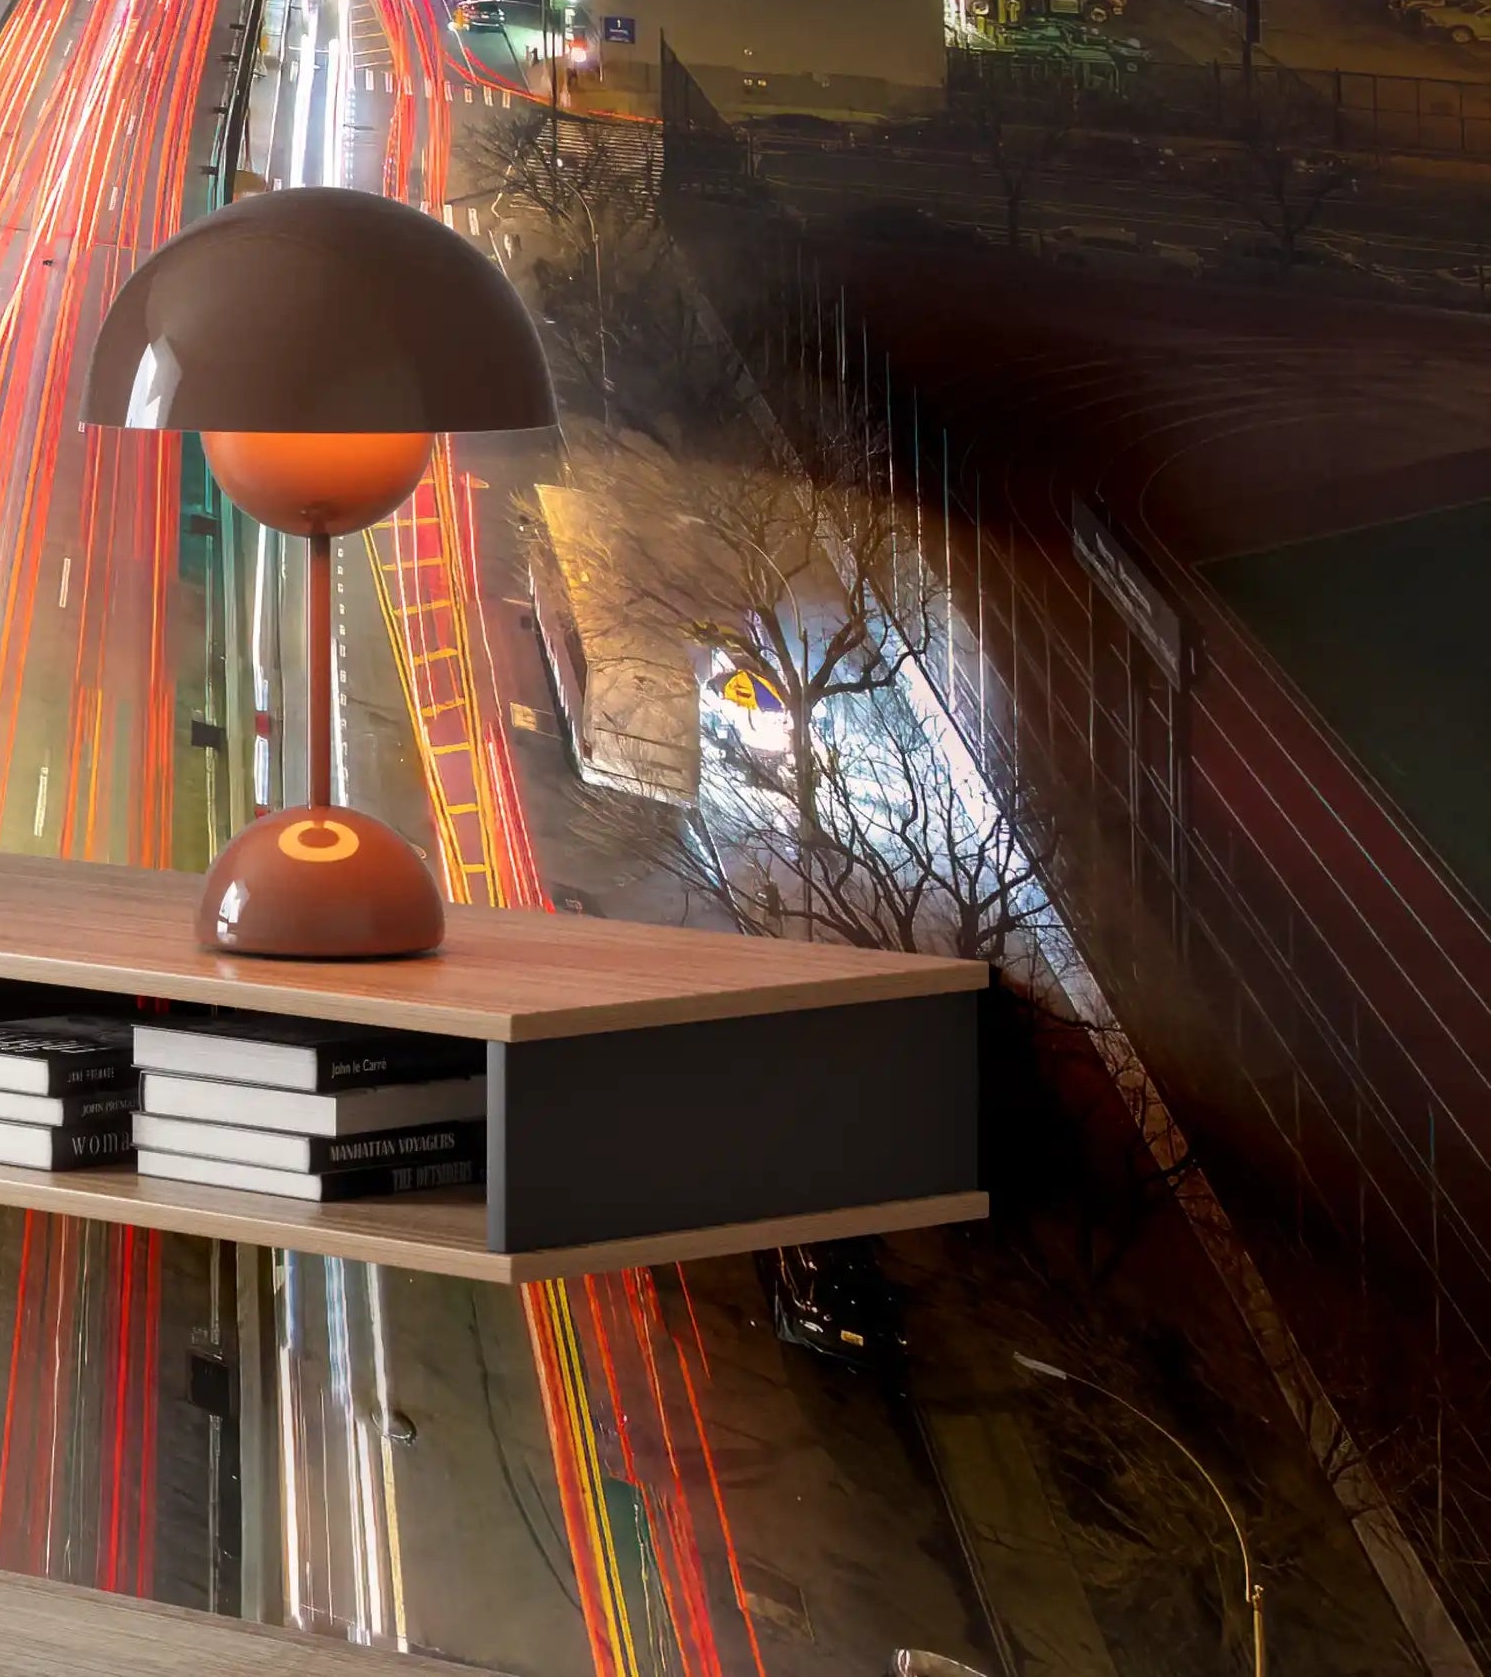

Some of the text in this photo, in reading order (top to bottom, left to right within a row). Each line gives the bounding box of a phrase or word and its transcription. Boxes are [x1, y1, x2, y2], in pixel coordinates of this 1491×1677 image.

[331, 1057, 387, 1079] John le Carré
[81, 1103, 103, 1117] JOHN
[330, 1133, 456, 1162] MANHATTAN VOYAGERS
